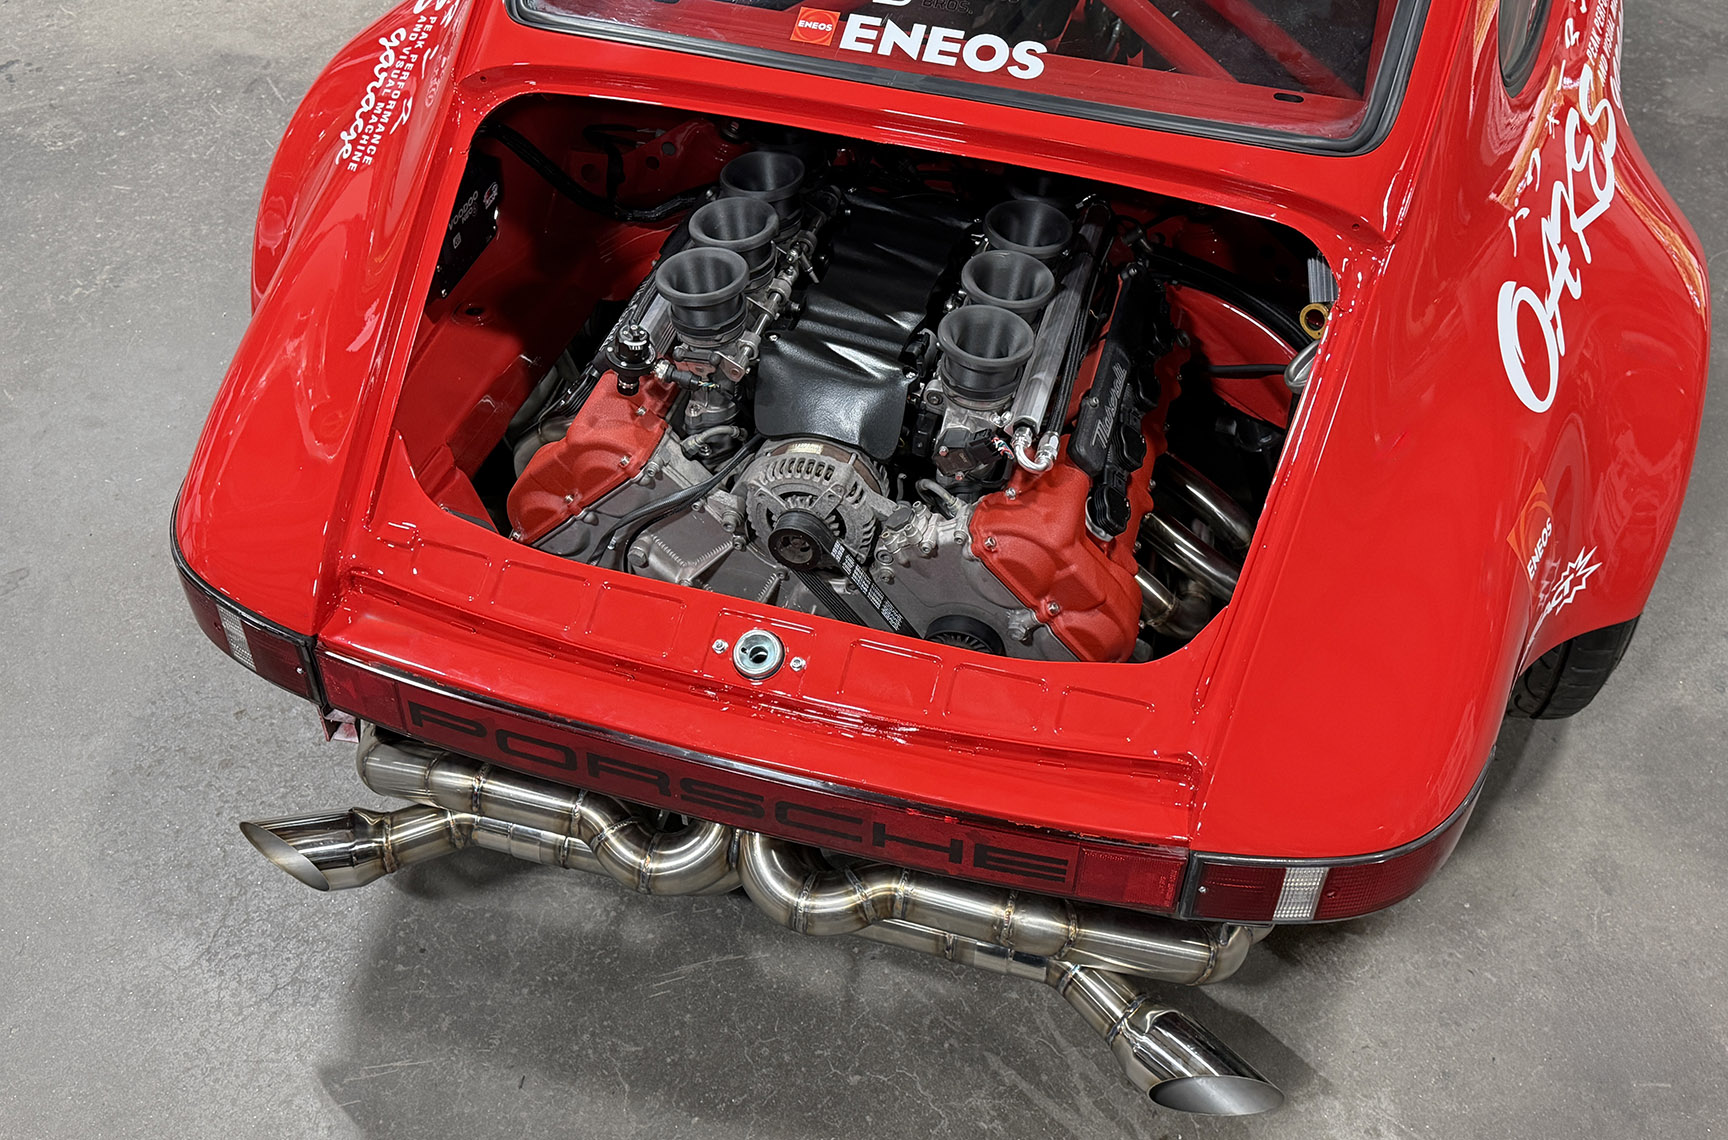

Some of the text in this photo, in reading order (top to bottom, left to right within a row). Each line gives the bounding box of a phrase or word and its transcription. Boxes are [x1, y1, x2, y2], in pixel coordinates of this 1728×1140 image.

[414, 16, 438, 49] PEAK
[797, 20, 833, 32] ENEOS
[839, 13, 1048, 80] ENEOS
[1586, 27, 1601, 67] PEAK
[347, 15, 427, 172] AND VISUAL MACHINE
[1597, 53, 1608, 88] AND
[362, 54, 419, 166] PERFORMANCE
[1091, 362, 1128, 449] Maserati
[1527, 517, 1553, 581] ENEOS
[408, 701, 1069, 883] PORSCHE
